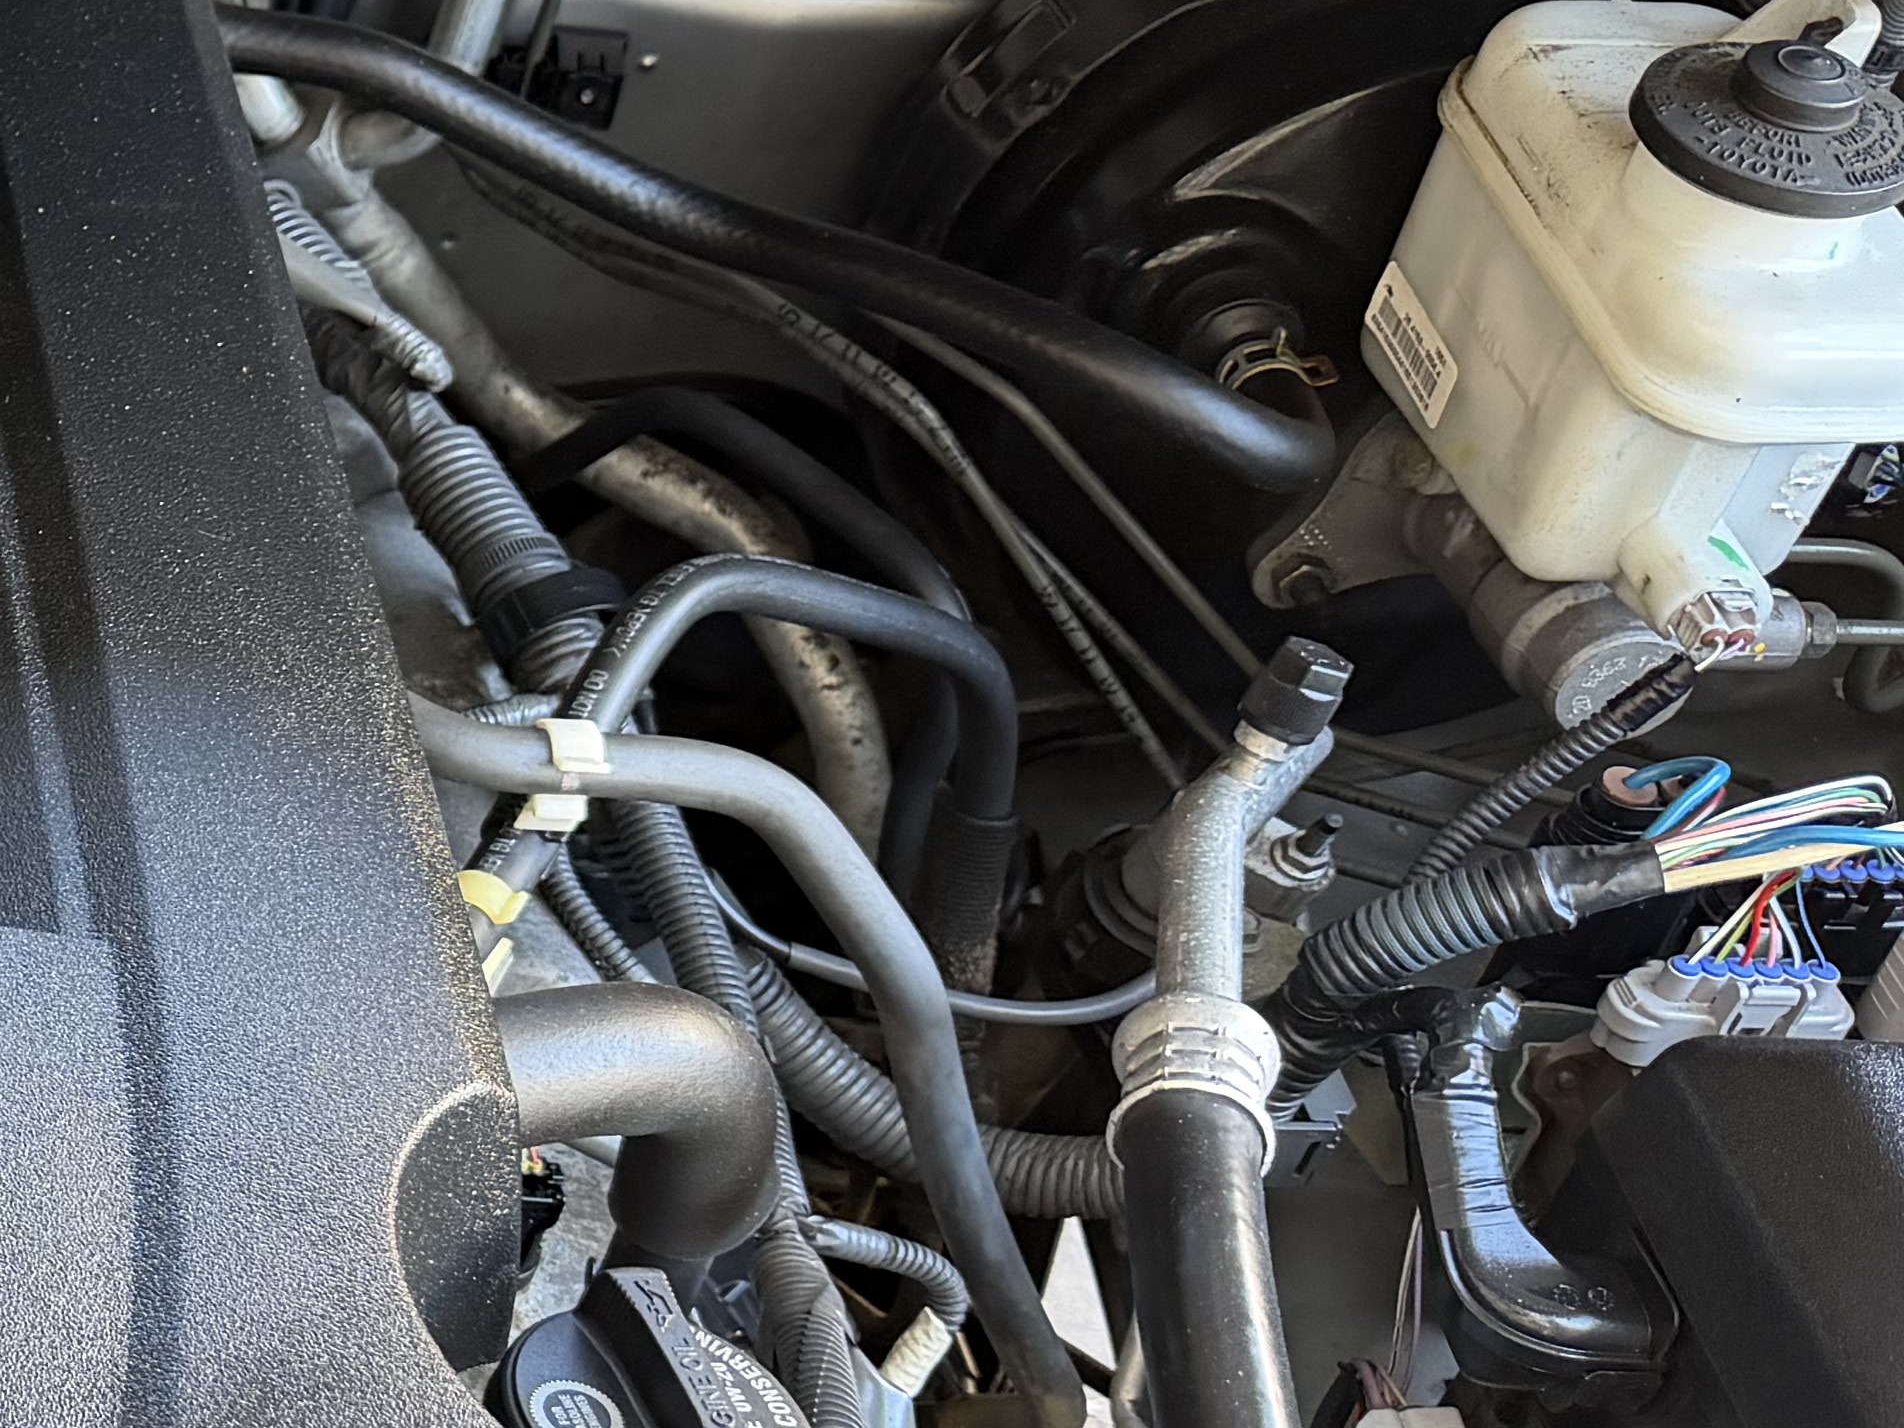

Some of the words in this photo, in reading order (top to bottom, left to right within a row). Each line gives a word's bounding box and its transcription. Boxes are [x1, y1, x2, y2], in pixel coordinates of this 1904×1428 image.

[1741, 136, 1813, 167] FLUID
[671, 1337, 705, 1374] OIL
[692, 1325, 800, 1428] CONSERVIN
